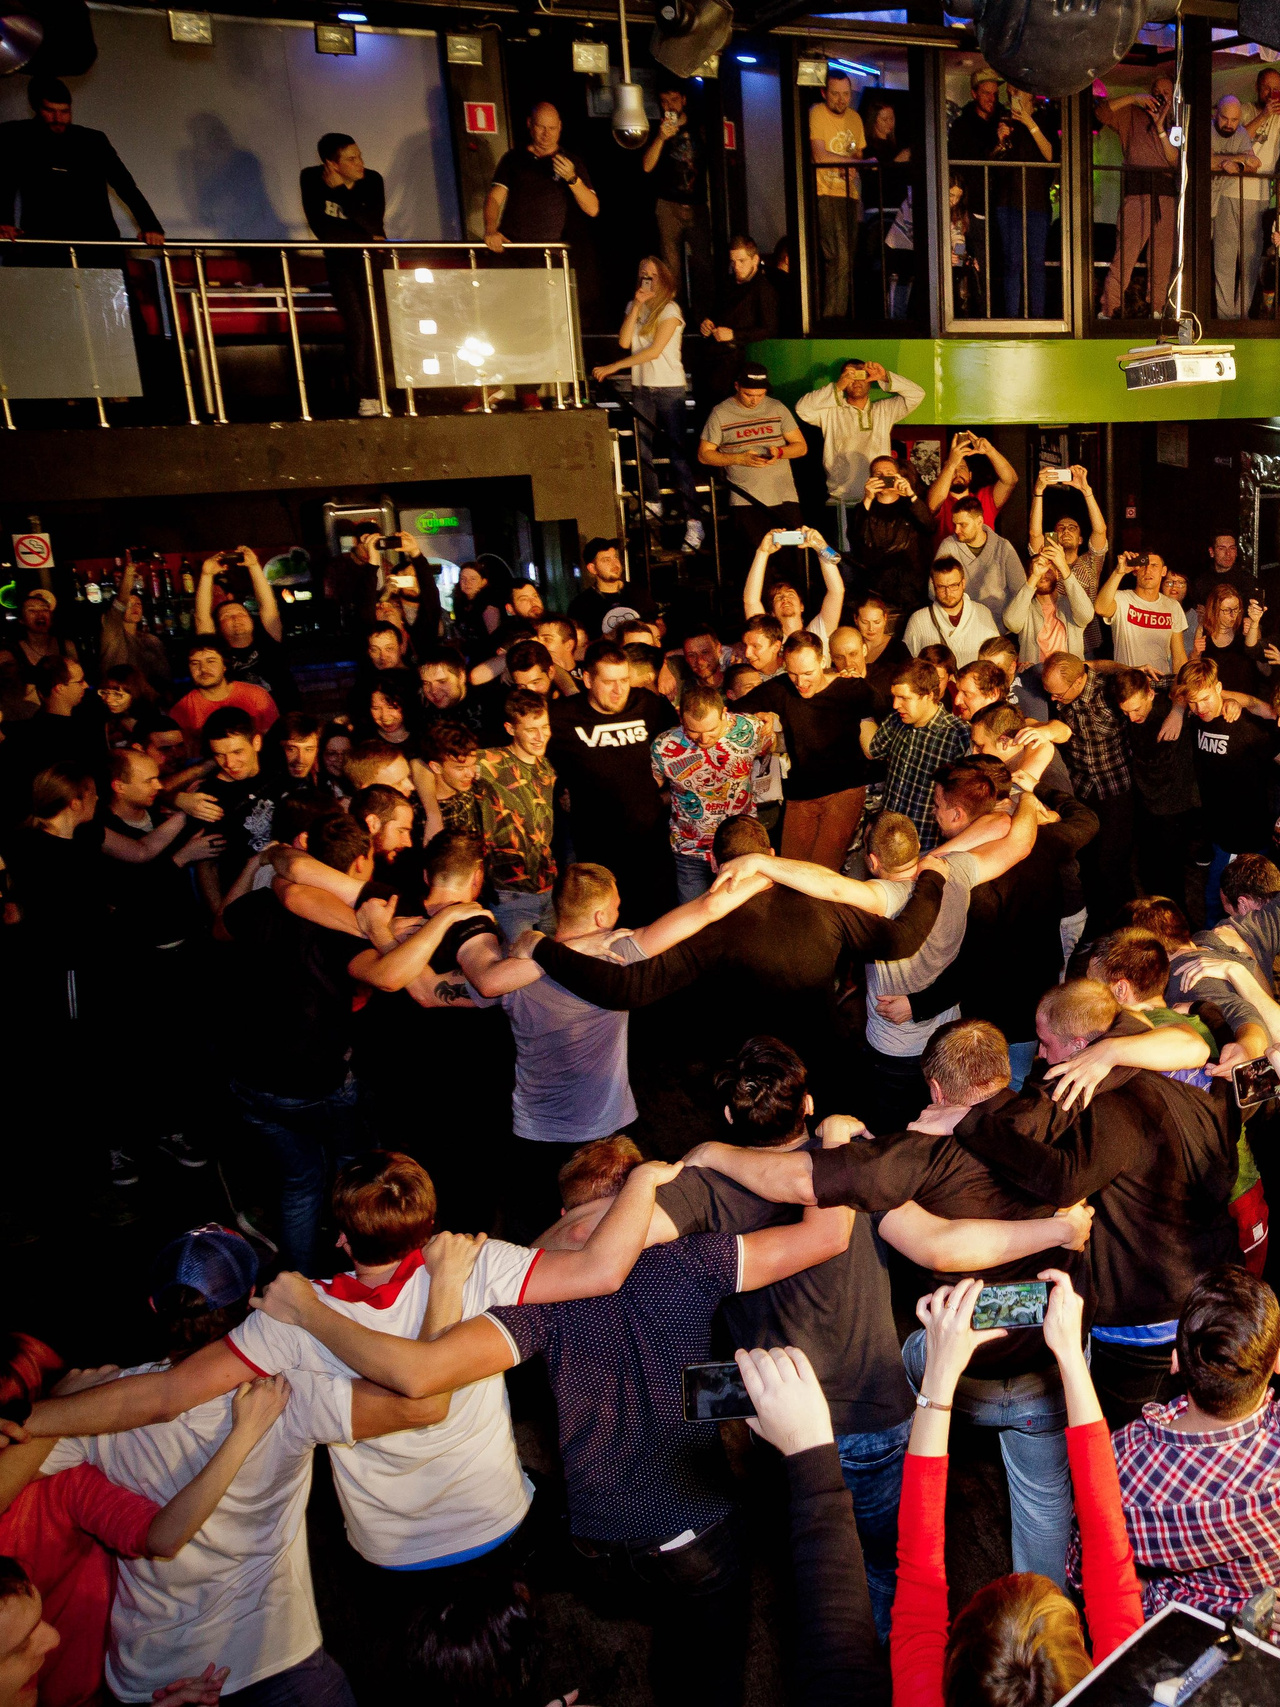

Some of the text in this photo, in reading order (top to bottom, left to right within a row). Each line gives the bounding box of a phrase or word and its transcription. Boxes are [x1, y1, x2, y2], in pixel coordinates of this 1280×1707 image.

[1128, 607, 1173, 626] ФУТБОЛ
[574, 719, 649, 748] VANS
[1197, 729, 1230, 755] VANS
